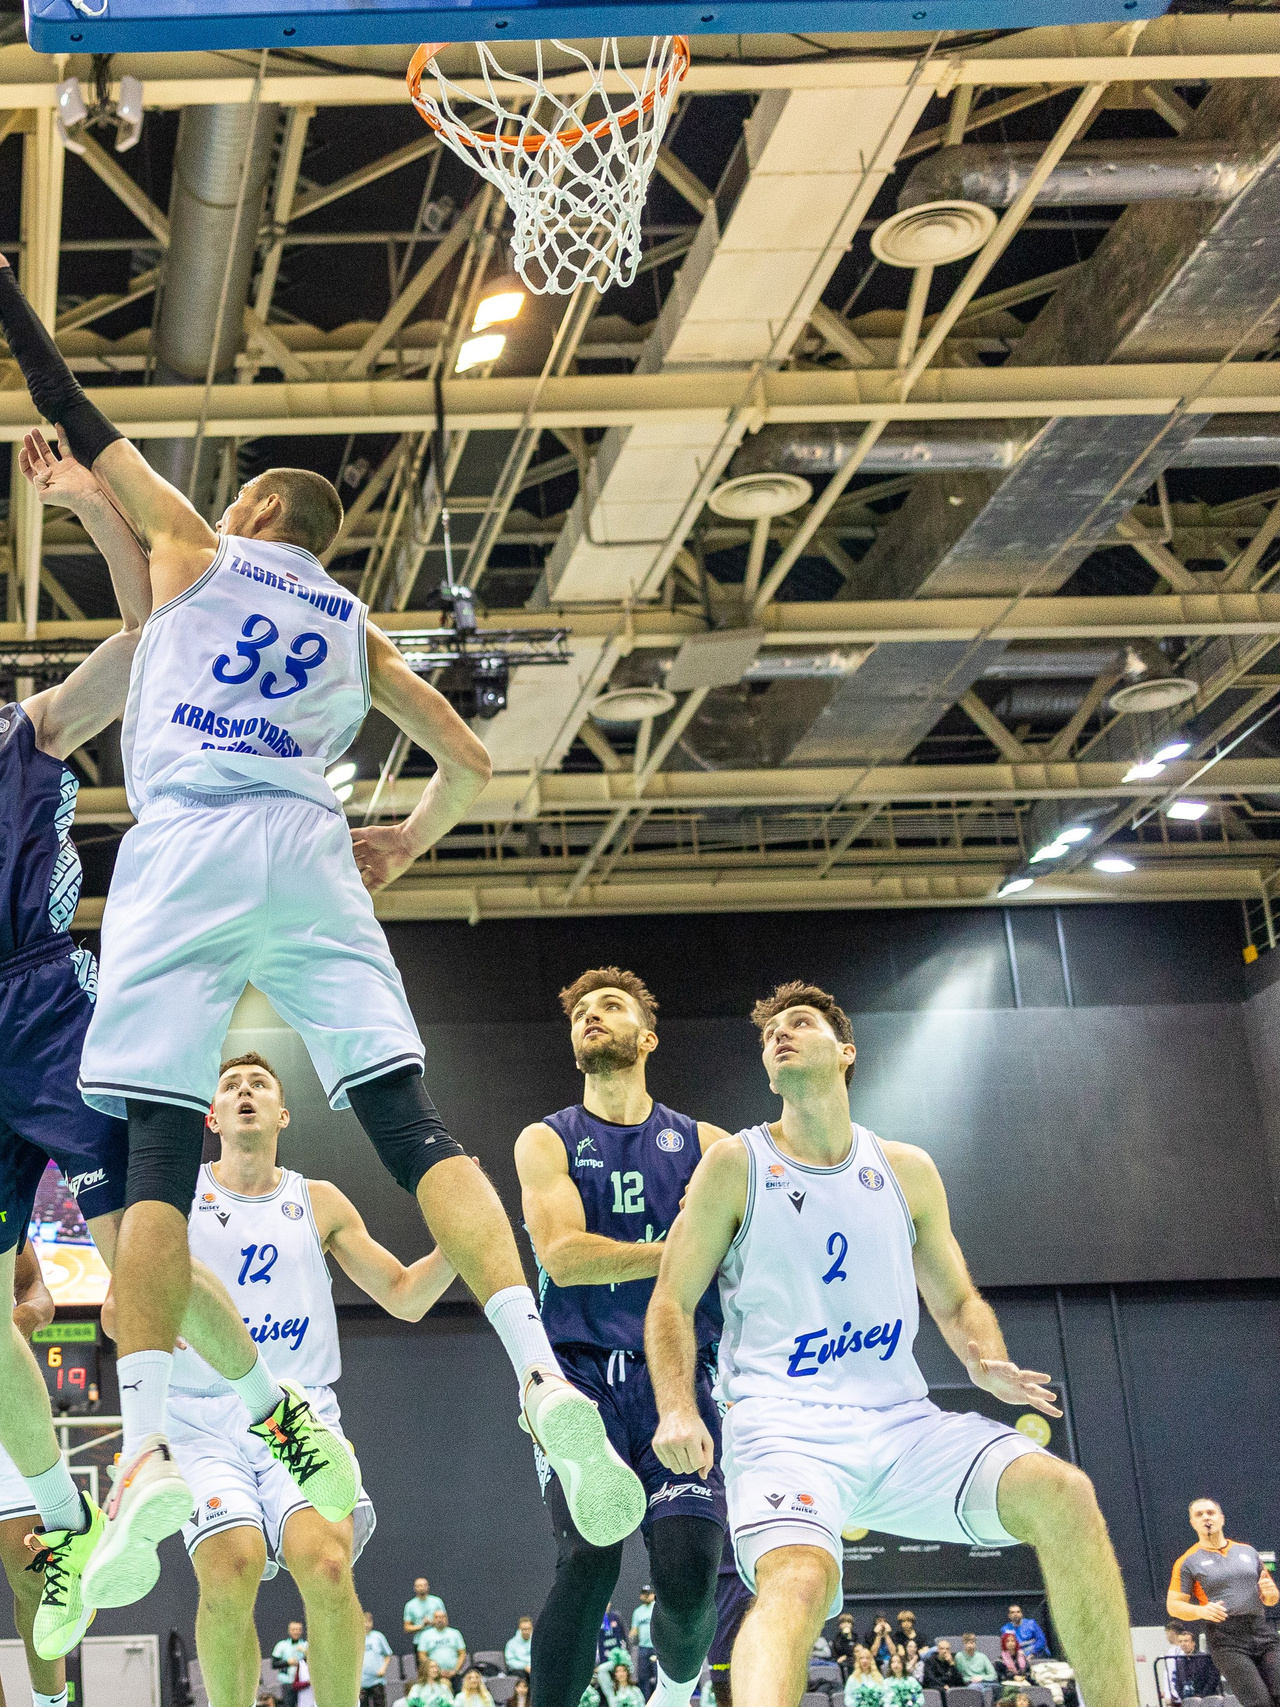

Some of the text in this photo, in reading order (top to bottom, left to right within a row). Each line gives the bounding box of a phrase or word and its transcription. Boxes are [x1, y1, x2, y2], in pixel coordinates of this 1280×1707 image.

[230, 555, 354, 622] ZAGRETDINOV
[212, 614, 328, 699] 33
[610, 1171, 645, 1214] 12
[238, 1244, 278, 1286] 12
[822, 1232, 848, 1284] 2
[243, 1313, 310, 1351] nisey
[786, 1318, 902, 1378] Enisey
[47, 1346, 62, 1368] 6
[56, 1367, 87, 1390] 19
[205, 1510, 228, 1521] ENISEY
[791, 1505, 818, 1515] ENISEY
